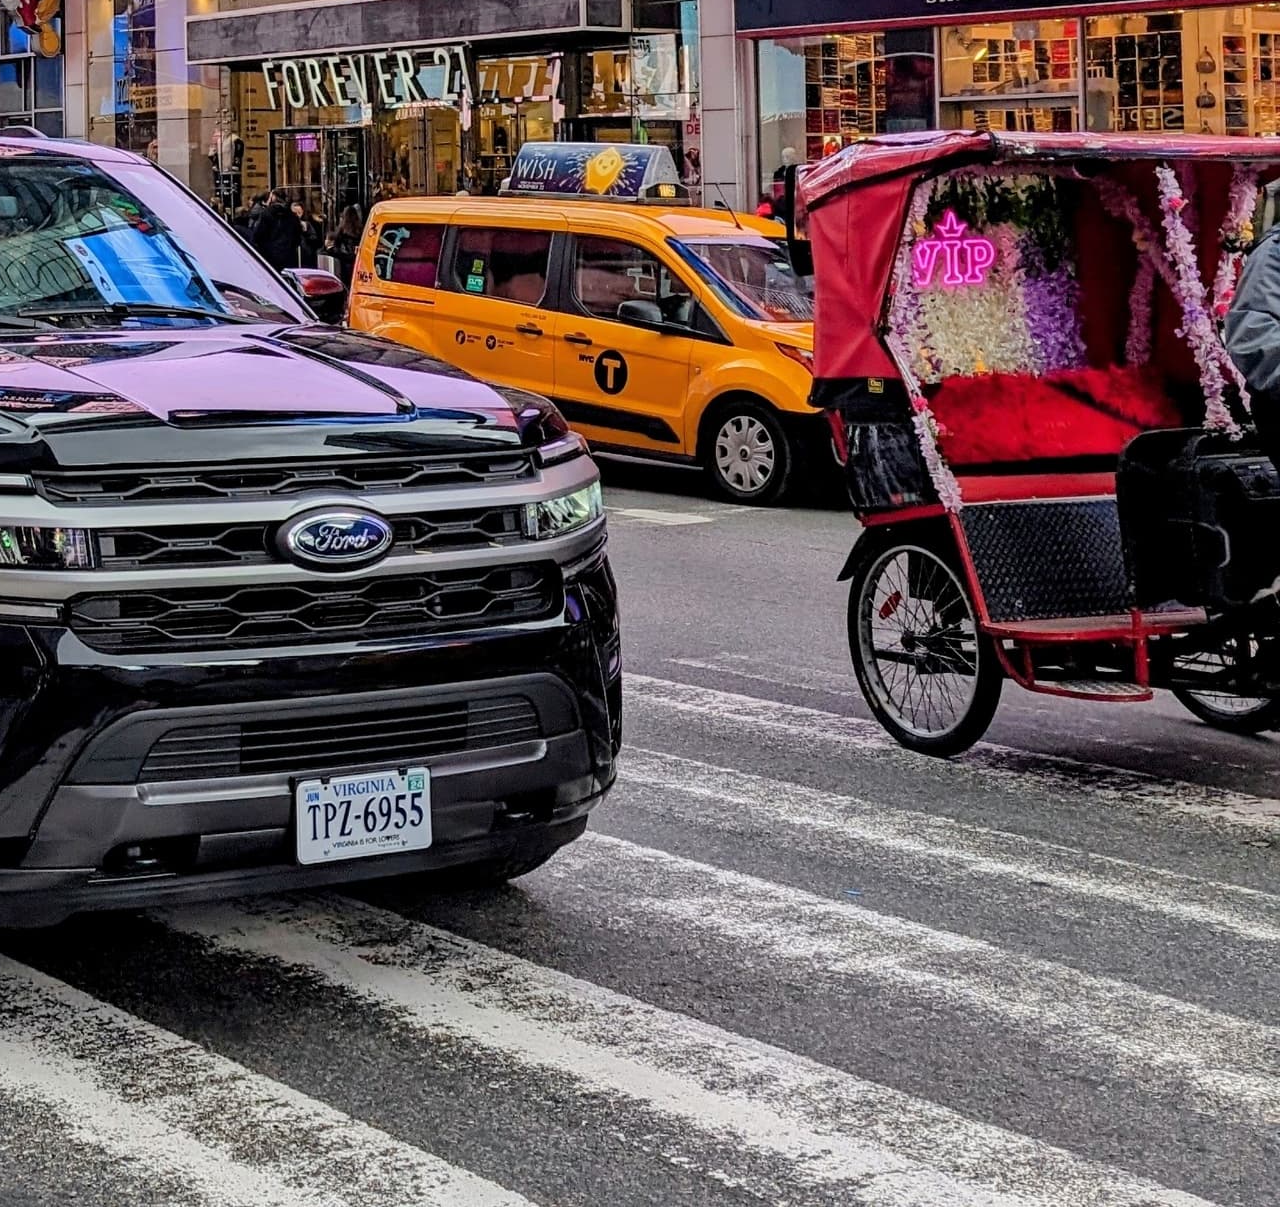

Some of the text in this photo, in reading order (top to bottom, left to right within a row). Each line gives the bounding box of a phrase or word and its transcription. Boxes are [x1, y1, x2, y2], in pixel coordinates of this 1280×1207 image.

[262, 45, 474, 111] FOREVER 21
[517, 158, 557, 180] WISH
[916, 238, 995, 285] VIP
[578, 353, 595, 364] NYC
[315, 522, 373, 552] Ford
[306, 792, 320, 802] JUN
[333, 778, 396, 797] VIRGINIA
[307, 792, 424, 841] TPZ-6955
[332, 839, 358, 848] VIRGINIA
